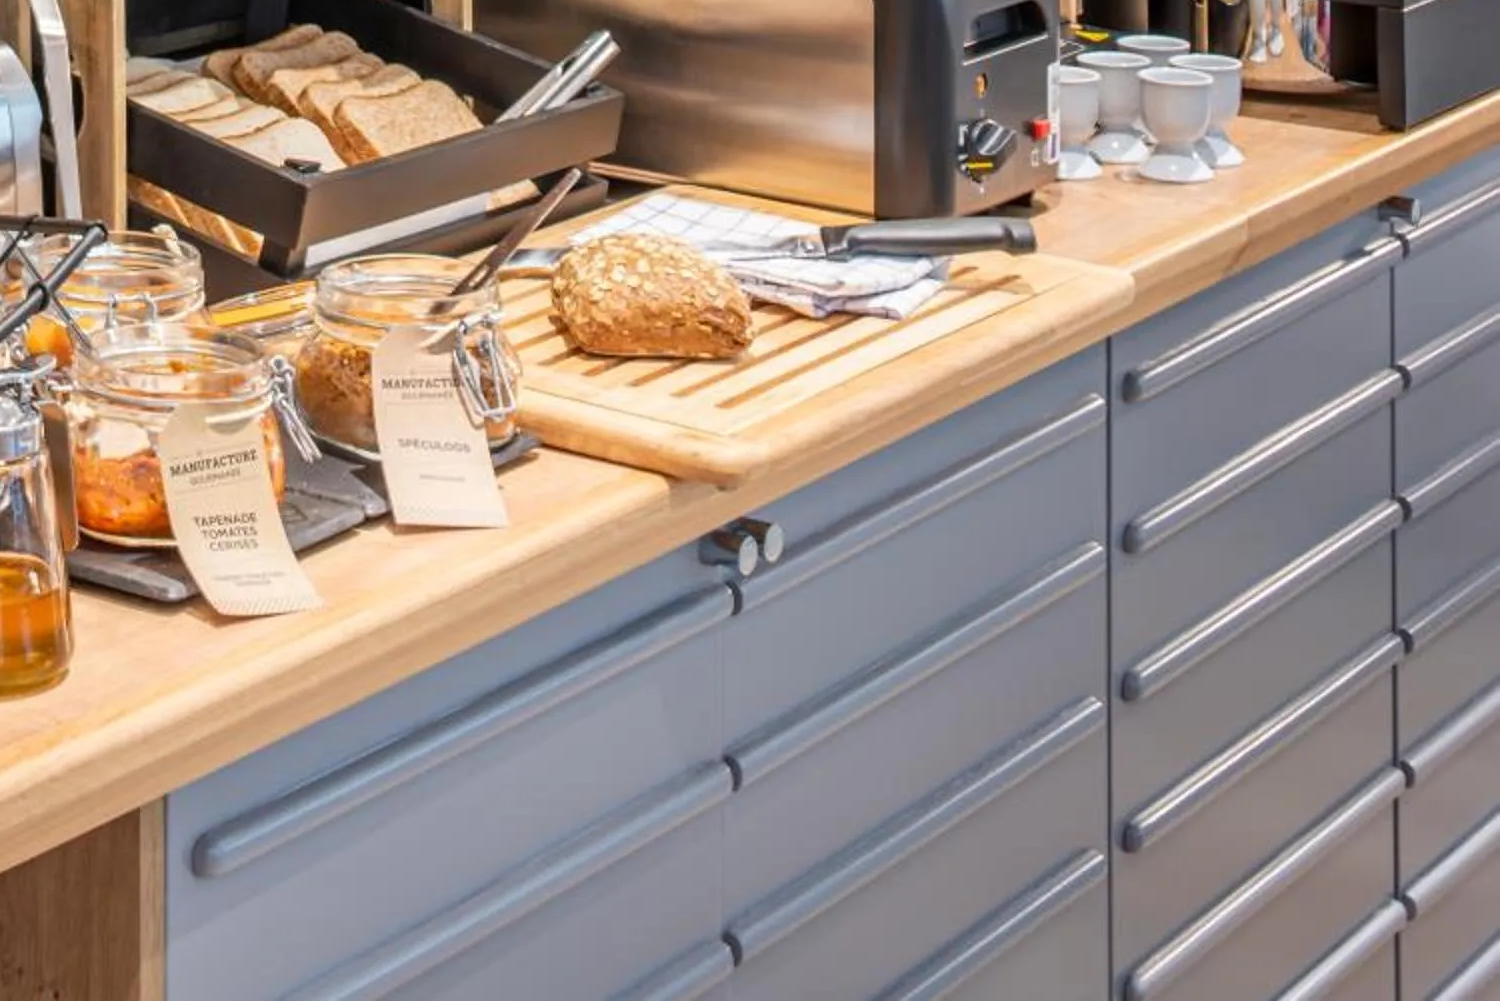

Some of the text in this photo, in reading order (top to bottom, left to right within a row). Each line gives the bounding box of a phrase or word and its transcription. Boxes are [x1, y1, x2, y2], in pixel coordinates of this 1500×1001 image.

[382, 378, 464, 390] MANUFACTU
[169, 449, 258, 477] MANUFACTURE
[193, 512, 257, 527] TAPENADE
[200, 526, 258, 540] TOMATES
